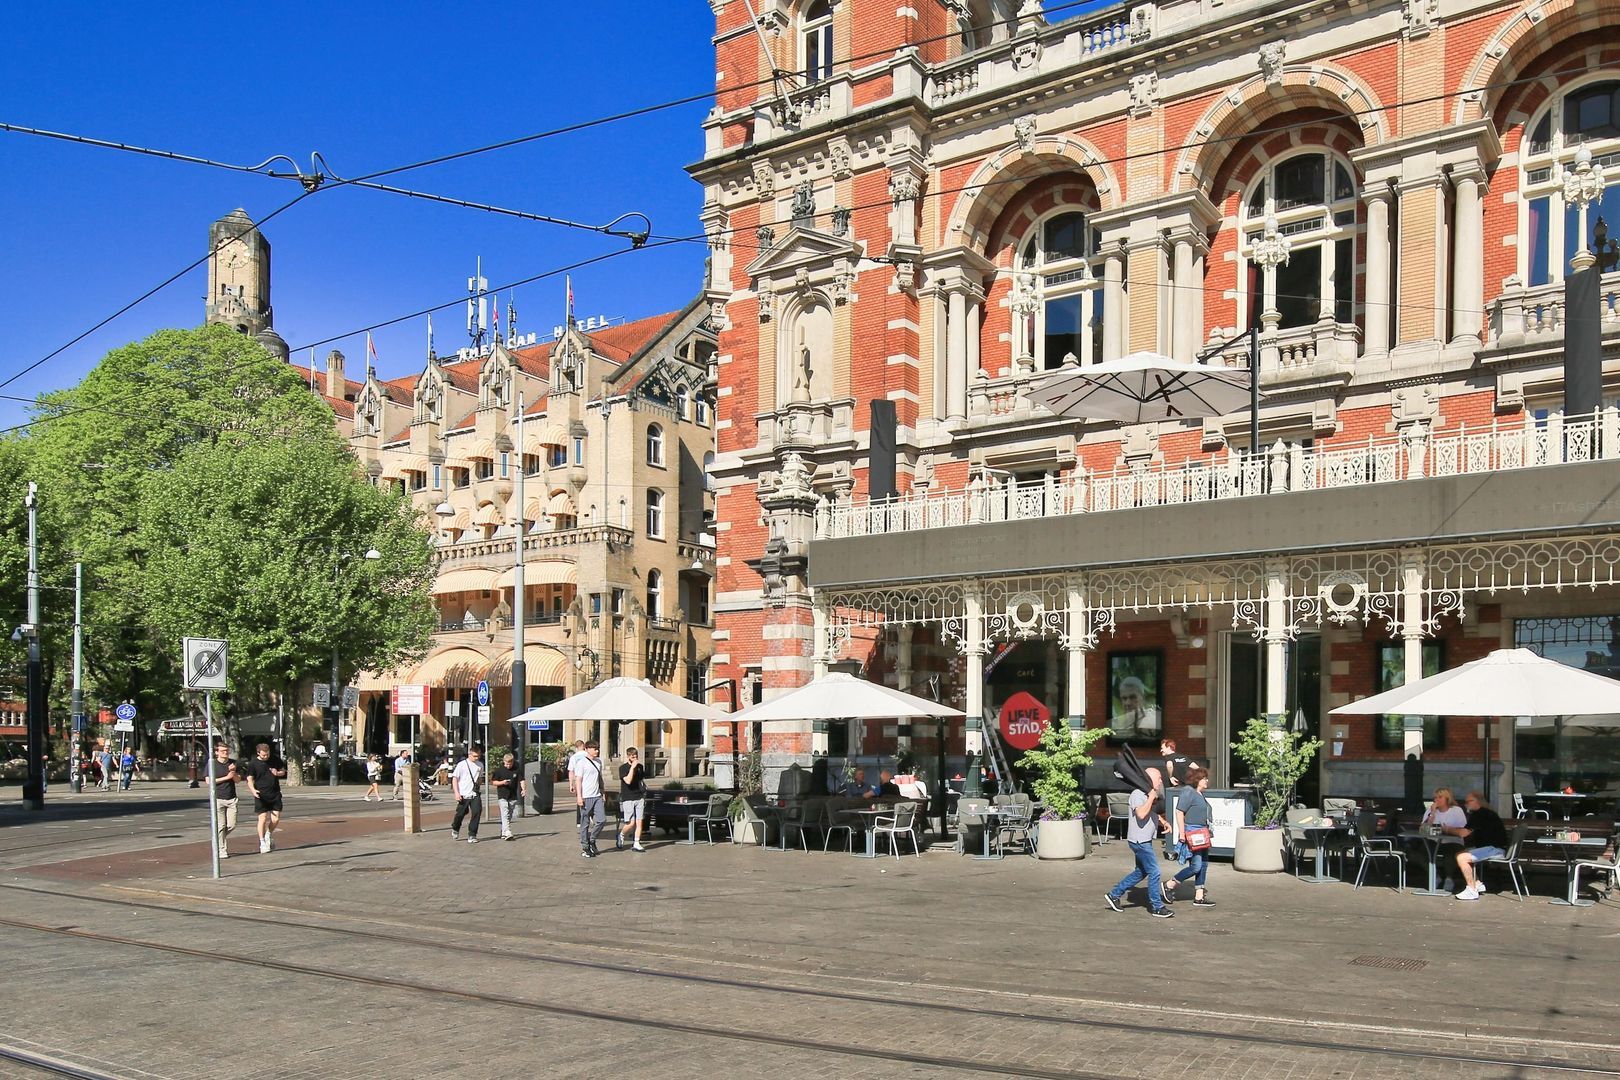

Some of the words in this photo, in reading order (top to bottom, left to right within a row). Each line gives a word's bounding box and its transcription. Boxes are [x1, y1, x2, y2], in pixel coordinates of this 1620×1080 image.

[459, 333, 536, 362] AMERCAN
[554, 315, 609, 338] HTEL
[1008, 708, 1039, 722] LIEVE
[1213, 819, 1233, 827] SERIE
